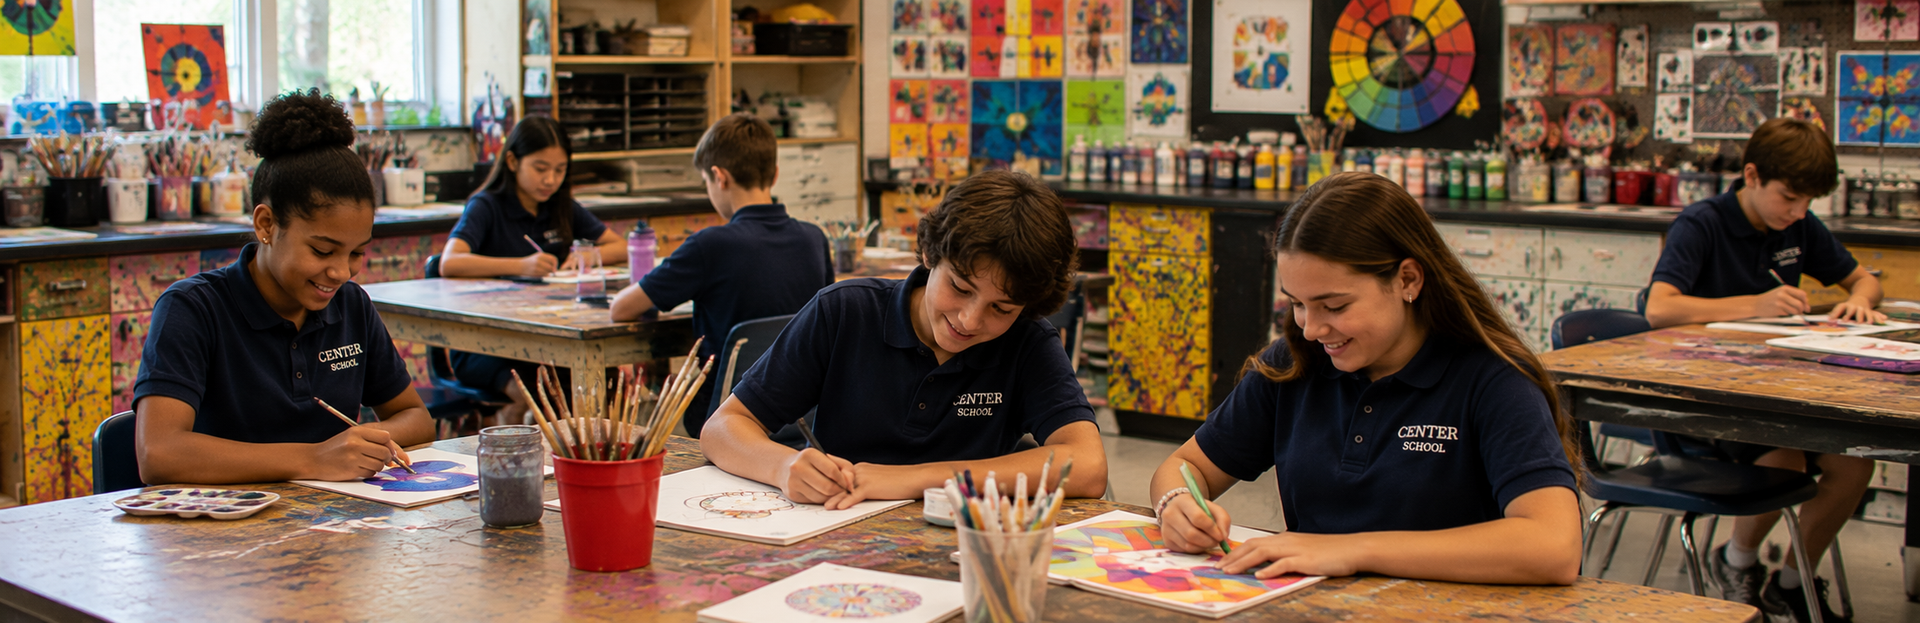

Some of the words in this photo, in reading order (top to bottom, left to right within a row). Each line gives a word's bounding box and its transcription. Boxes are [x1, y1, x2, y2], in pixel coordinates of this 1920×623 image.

[318, 343, 363, 363] CENTER
[330, 358, 359, 371] SCHOOL
[957, 407, 993, 417] SCHOOL
[1397, 424, 1459, 440] CENTER
[1402, 441, 1446, 453] SCHOOL
